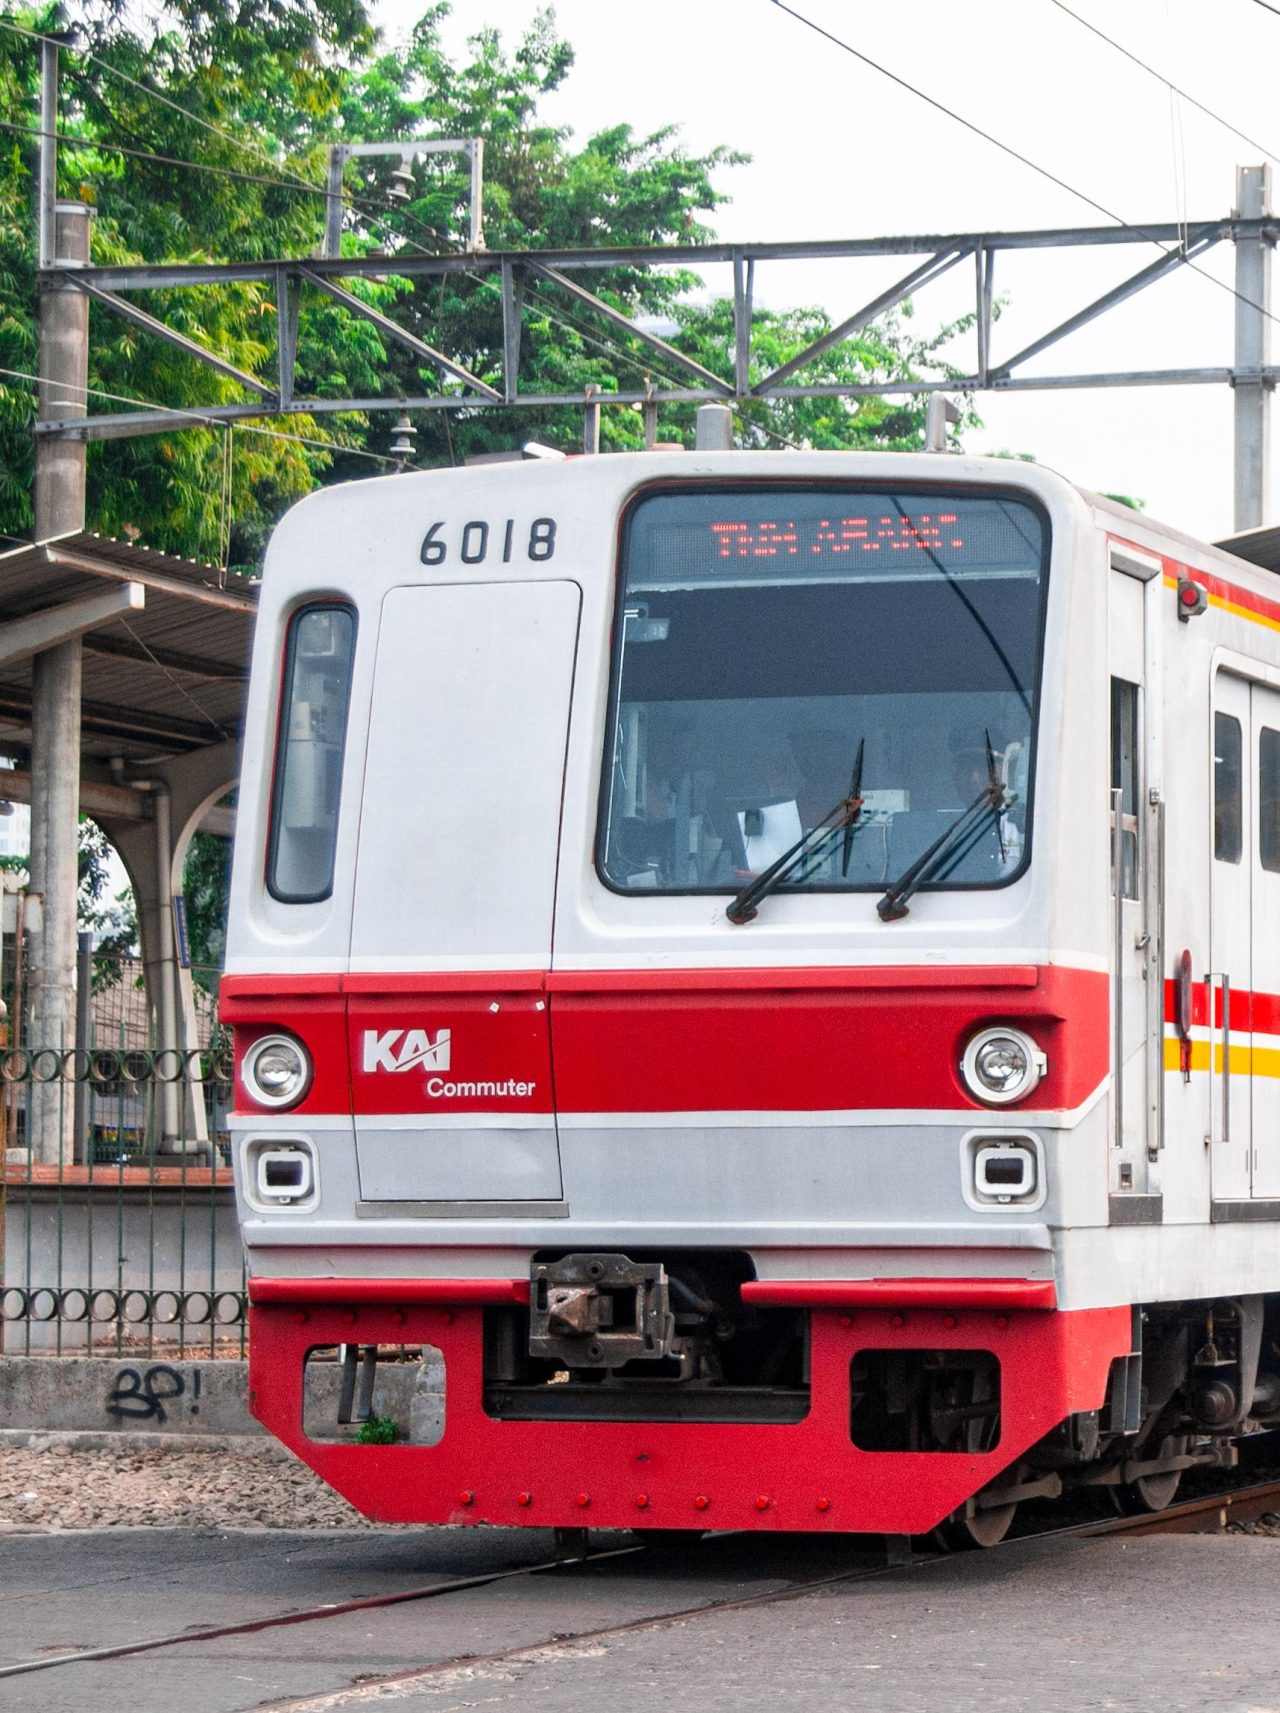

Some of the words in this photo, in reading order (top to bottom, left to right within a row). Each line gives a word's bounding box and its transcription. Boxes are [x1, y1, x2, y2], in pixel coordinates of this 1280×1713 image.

[420, 517, 558, 566] 6018
[363, 1028, 451, 1073] KAI
[426, 1076, 536, 1098] Commuter
